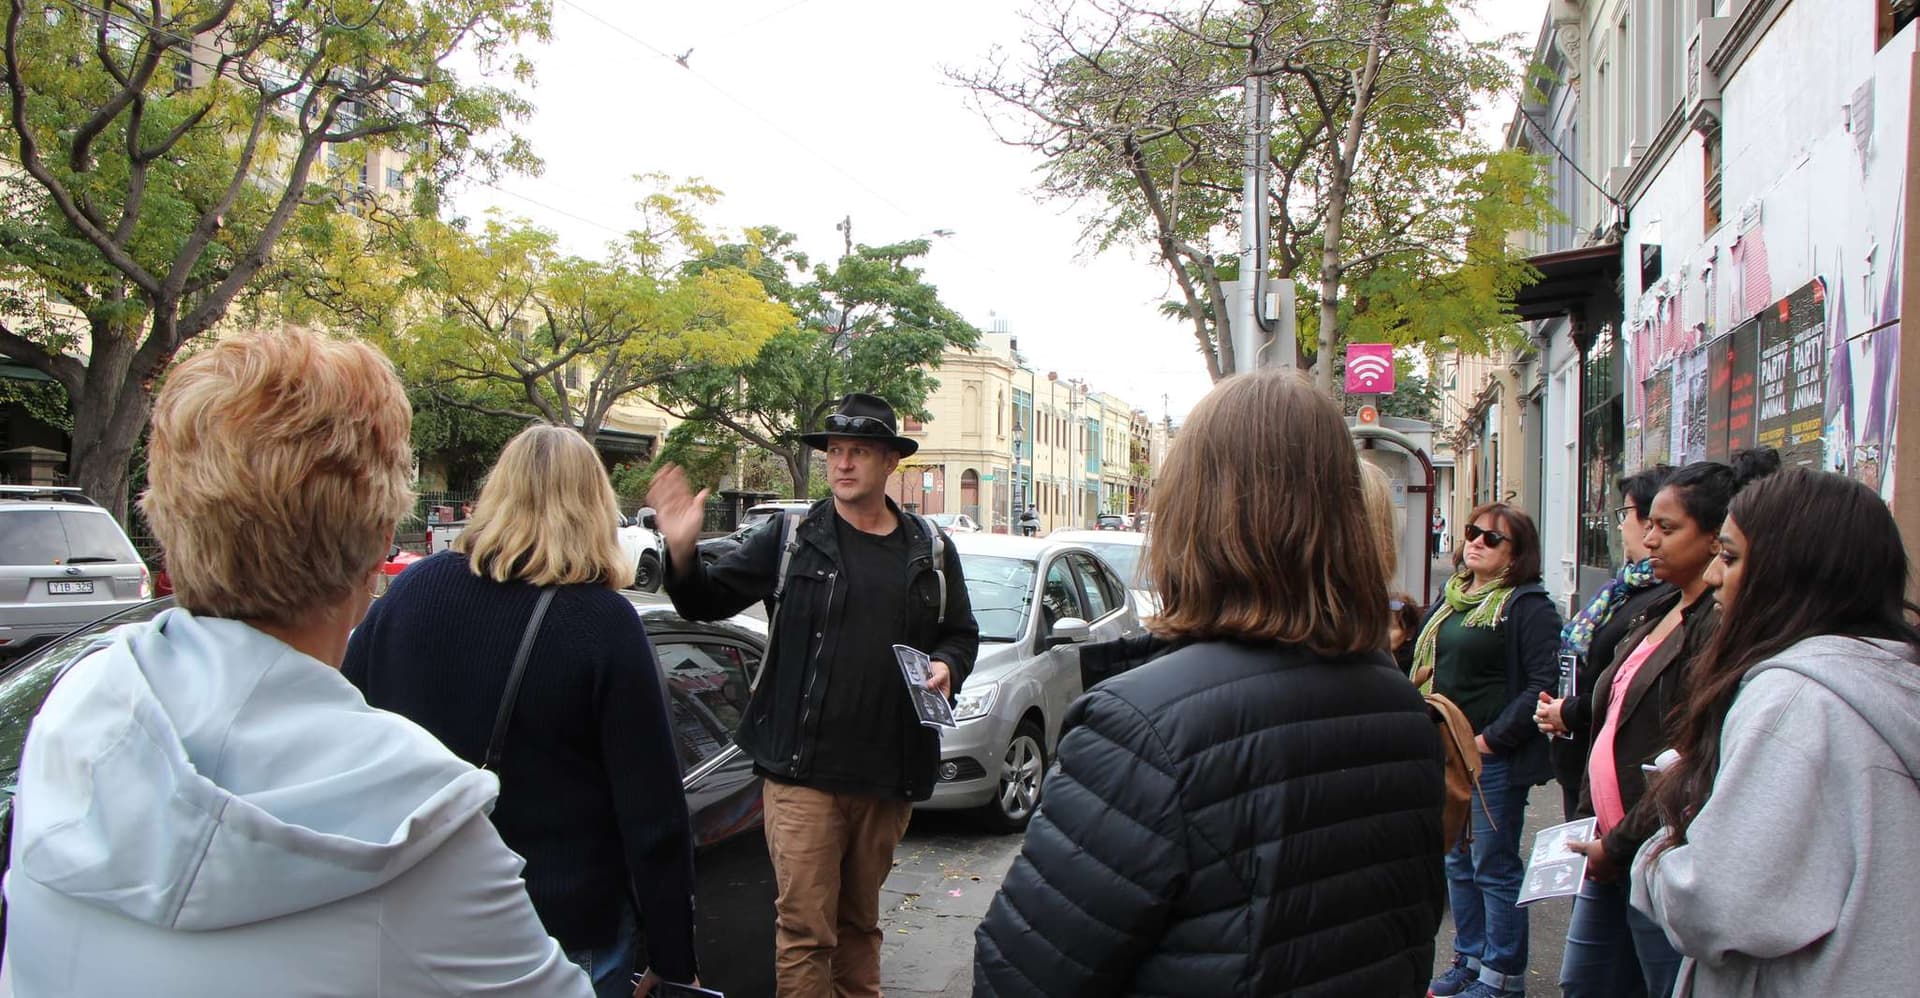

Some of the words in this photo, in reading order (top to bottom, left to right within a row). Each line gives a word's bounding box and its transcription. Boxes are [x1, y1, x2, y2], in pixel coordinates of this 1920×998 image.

[1794, 334, 1823, 373] PARTY
[1761, 352, 1788, 386] PARTY
[1809, 367, 1819, 383] AN
[1760, 395, 1787, 421] ANIMAL
[1792, 382, 1822, 412] ANIMAL
